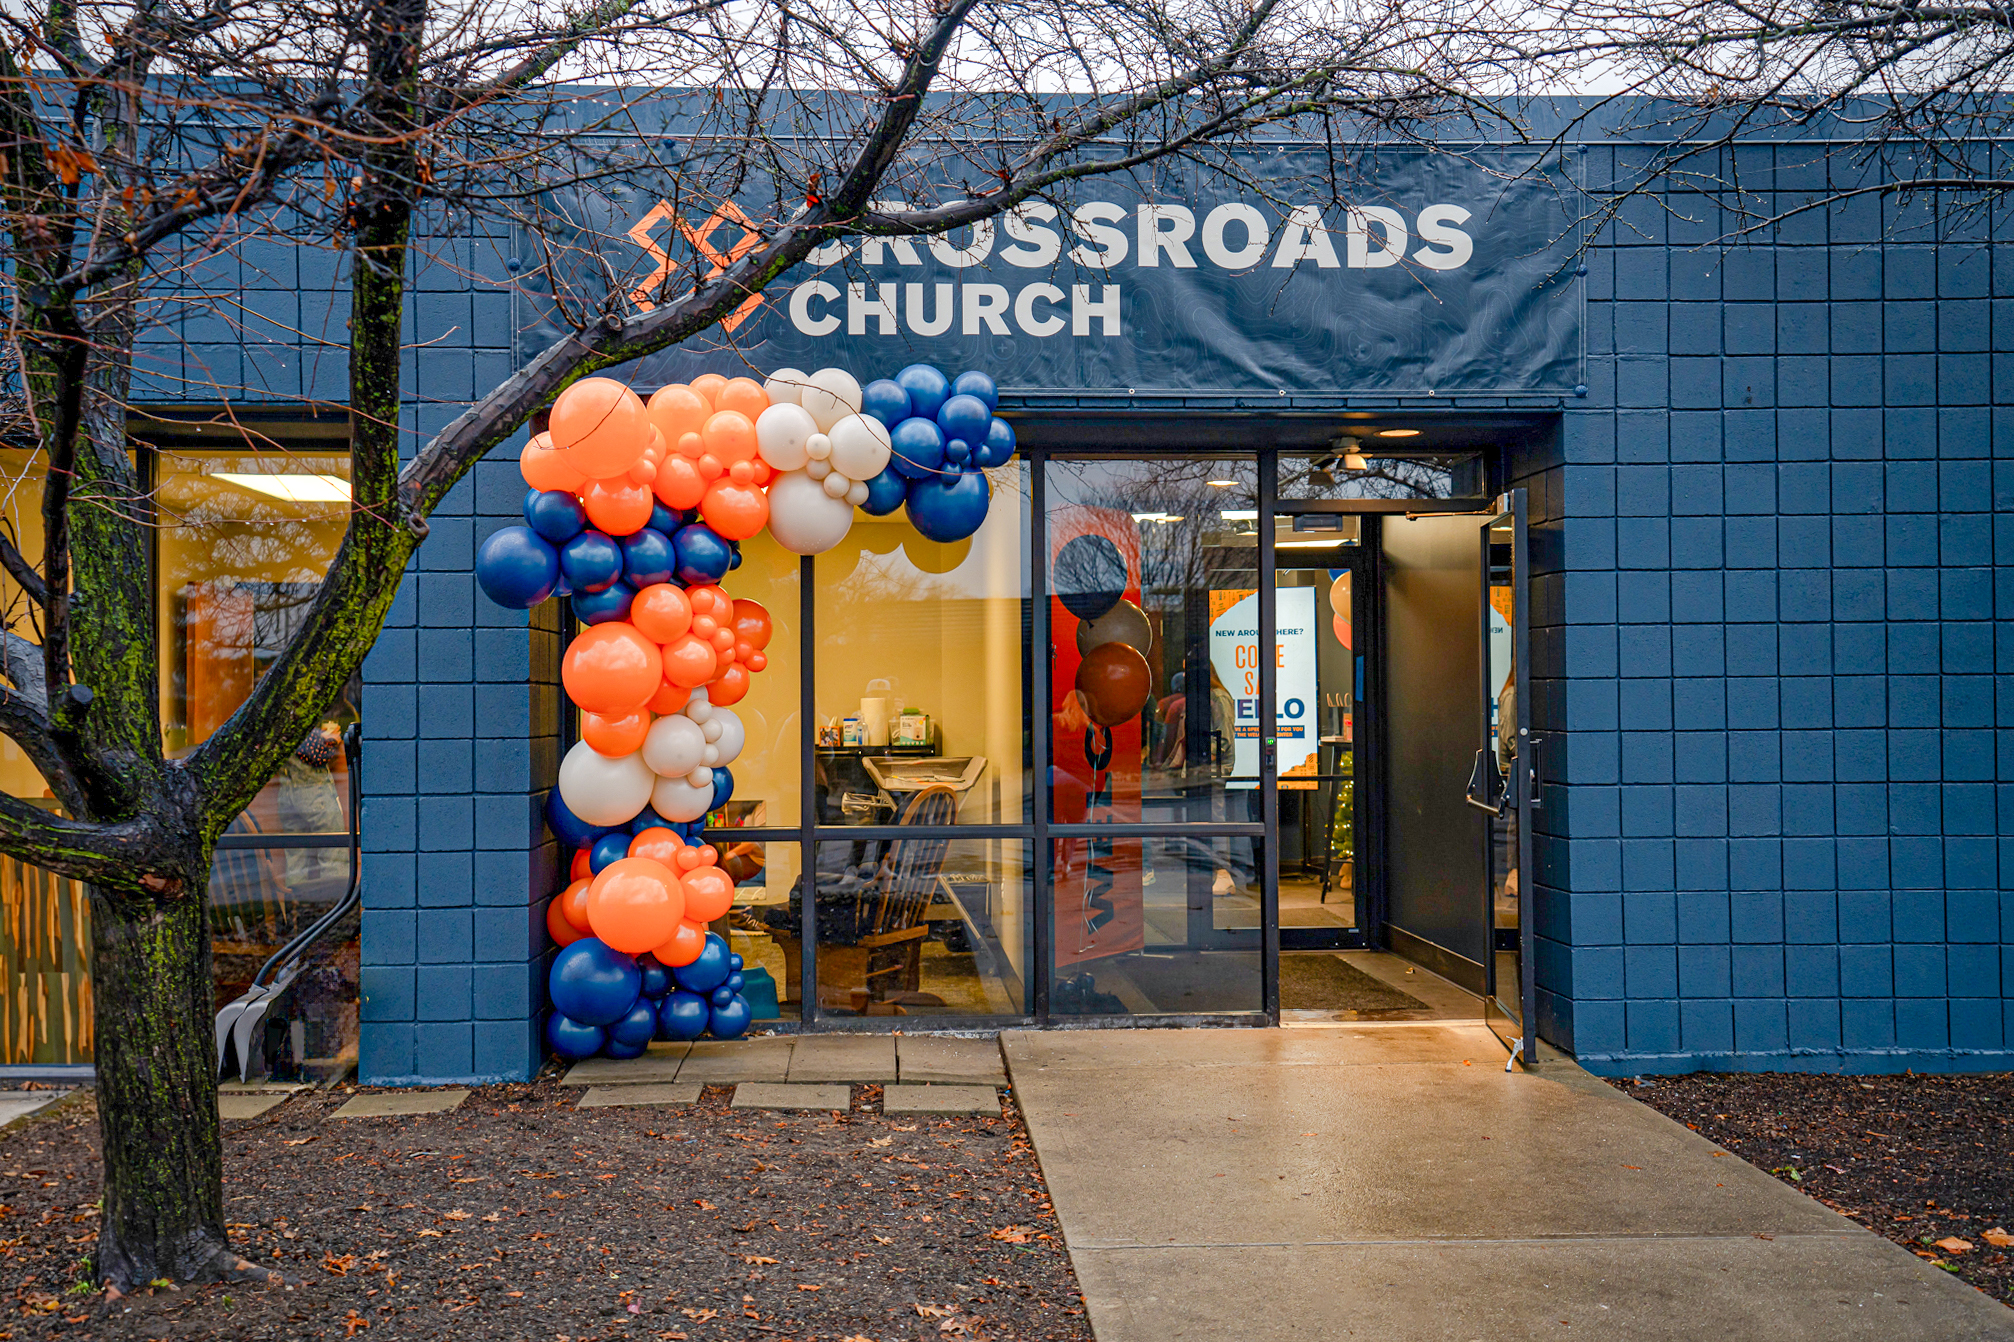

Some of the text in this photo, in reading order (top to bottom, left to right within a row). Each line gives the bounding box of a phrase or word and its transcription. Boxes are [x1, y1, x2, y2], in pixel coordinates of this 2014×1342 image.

[789, 280, 1122, 337] CHURCH
[1276, 628, 1304, 636] HERE?
[1235, 644, 1285, 669] COE
[1084, 723, 1114, 935] WELC
